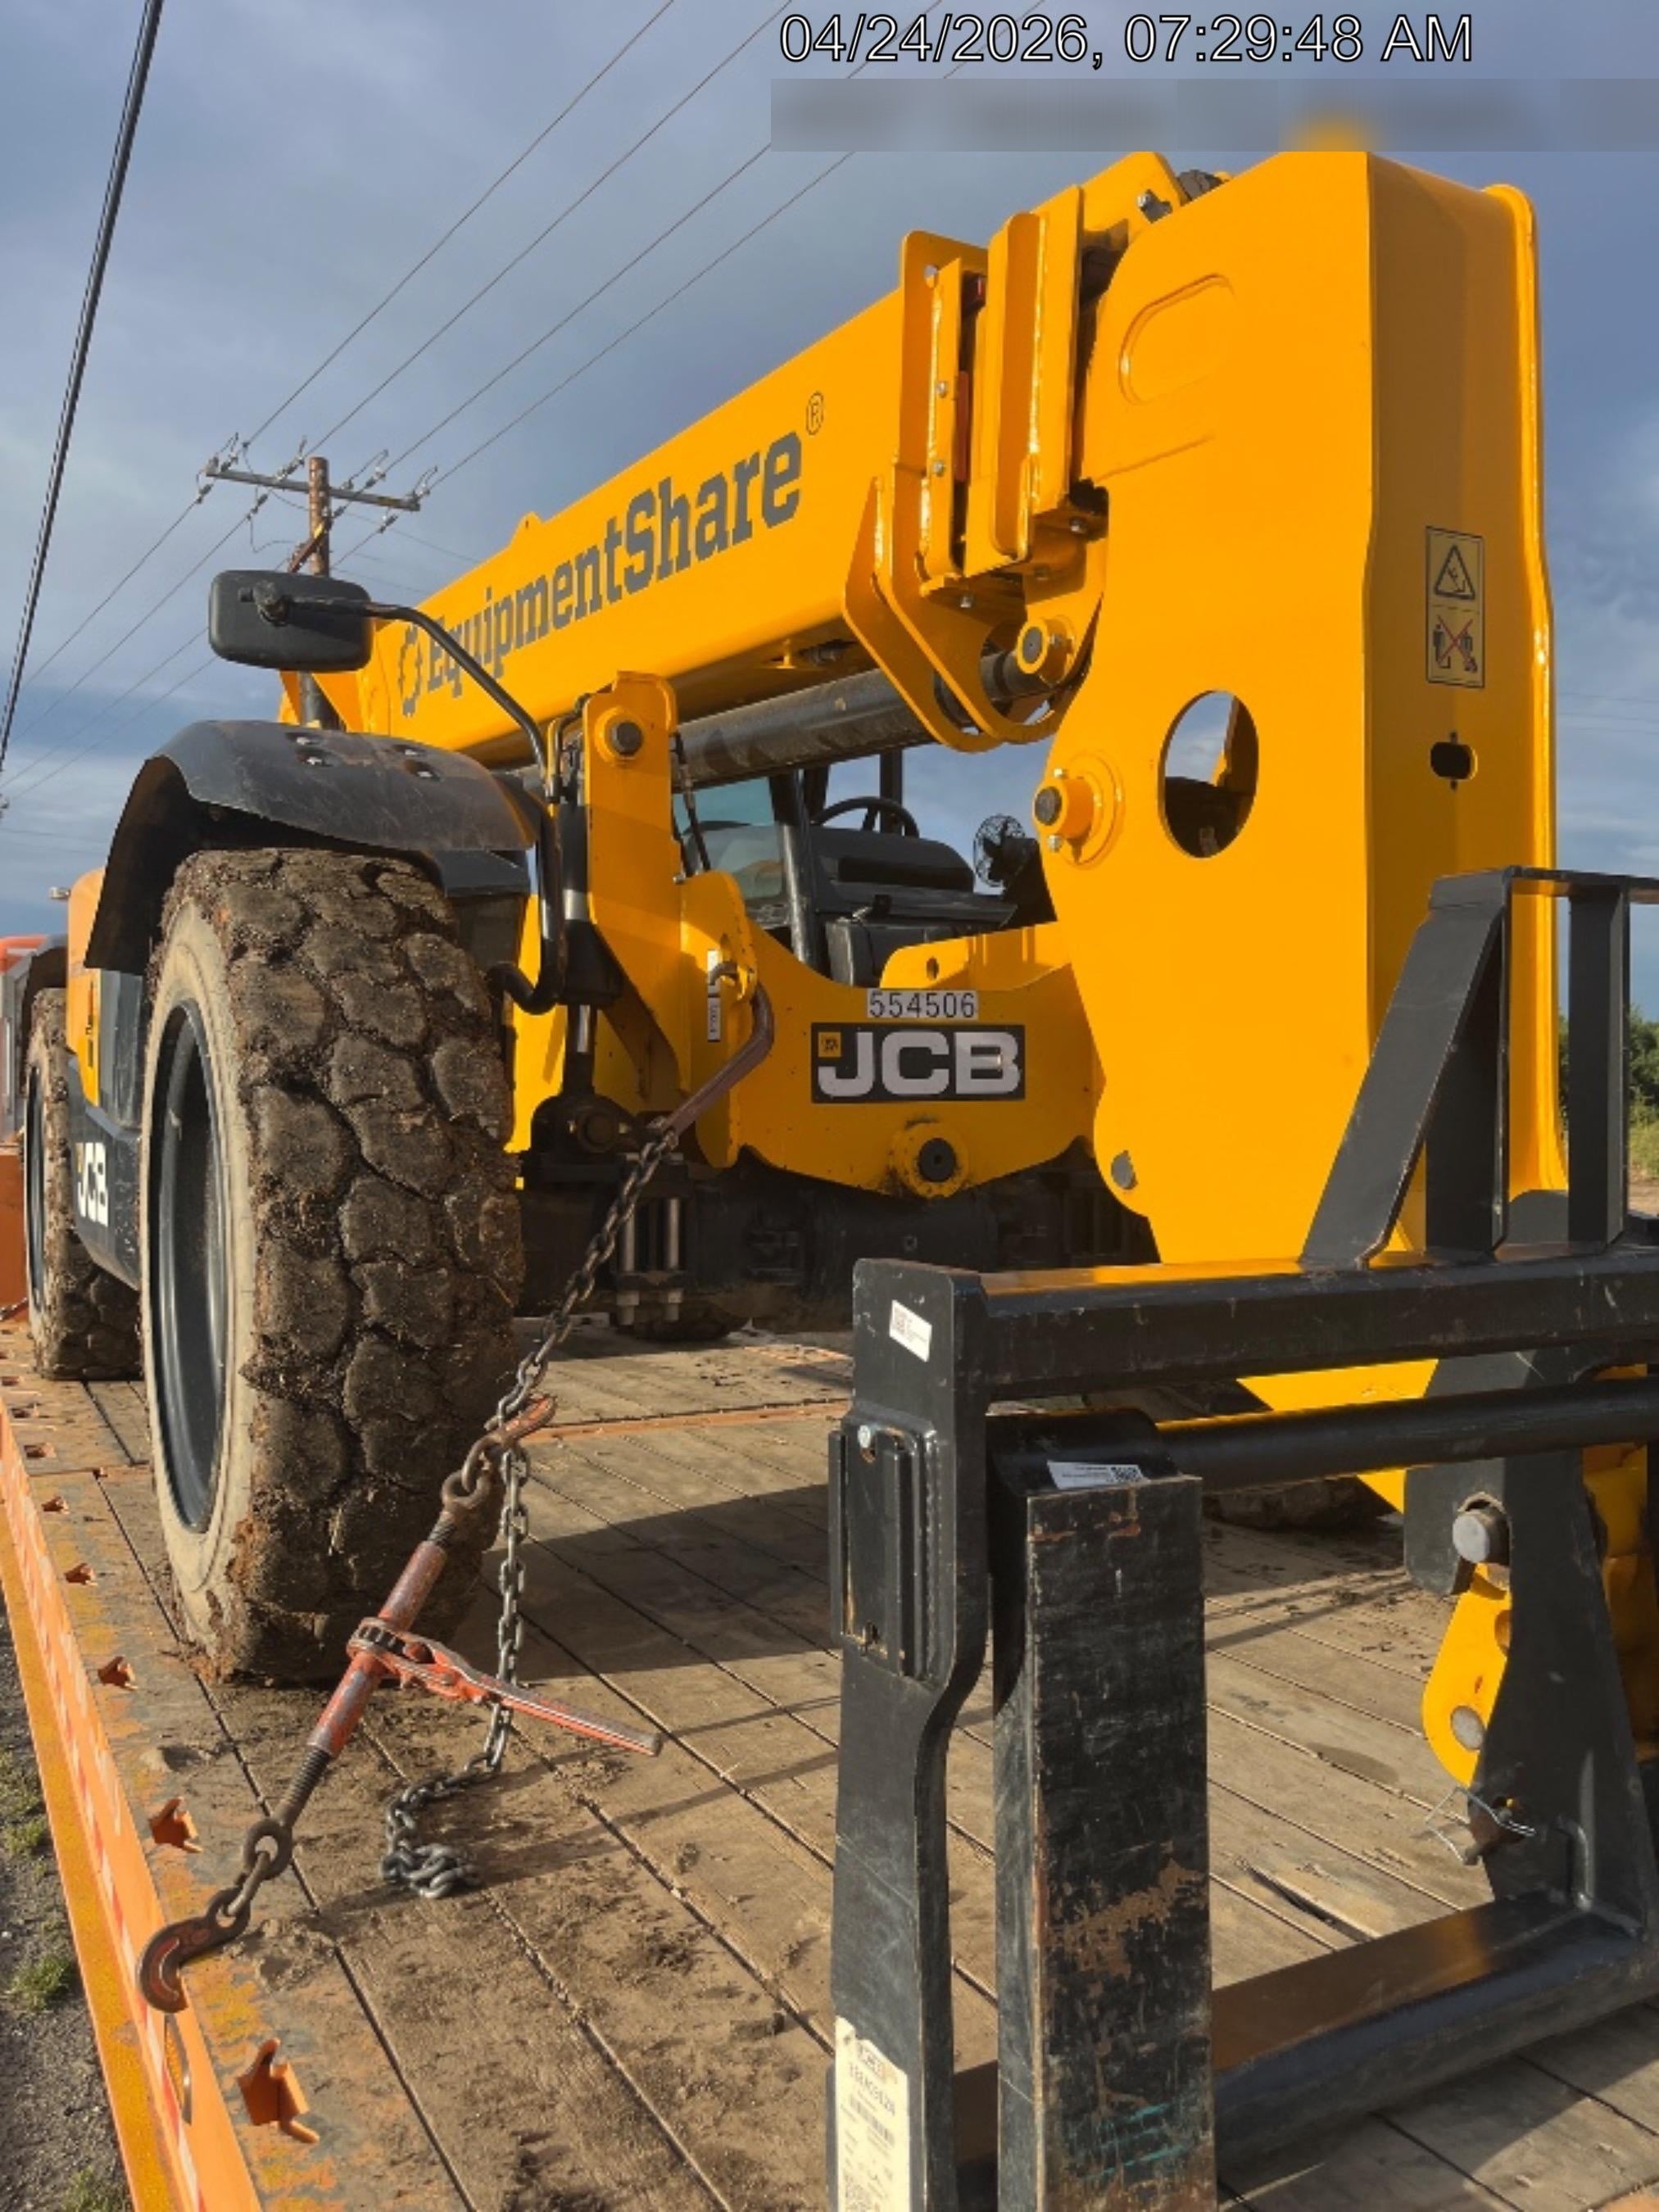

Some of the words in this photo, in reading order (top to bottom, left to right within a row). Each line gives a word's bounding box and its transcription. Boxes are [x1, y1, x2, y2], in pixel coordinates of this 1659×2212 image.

[868, 991, 976, 1018] 554506
[818, 1031, 1022, 1098] JCB
[77, 1142, 109, 1228] JCB
